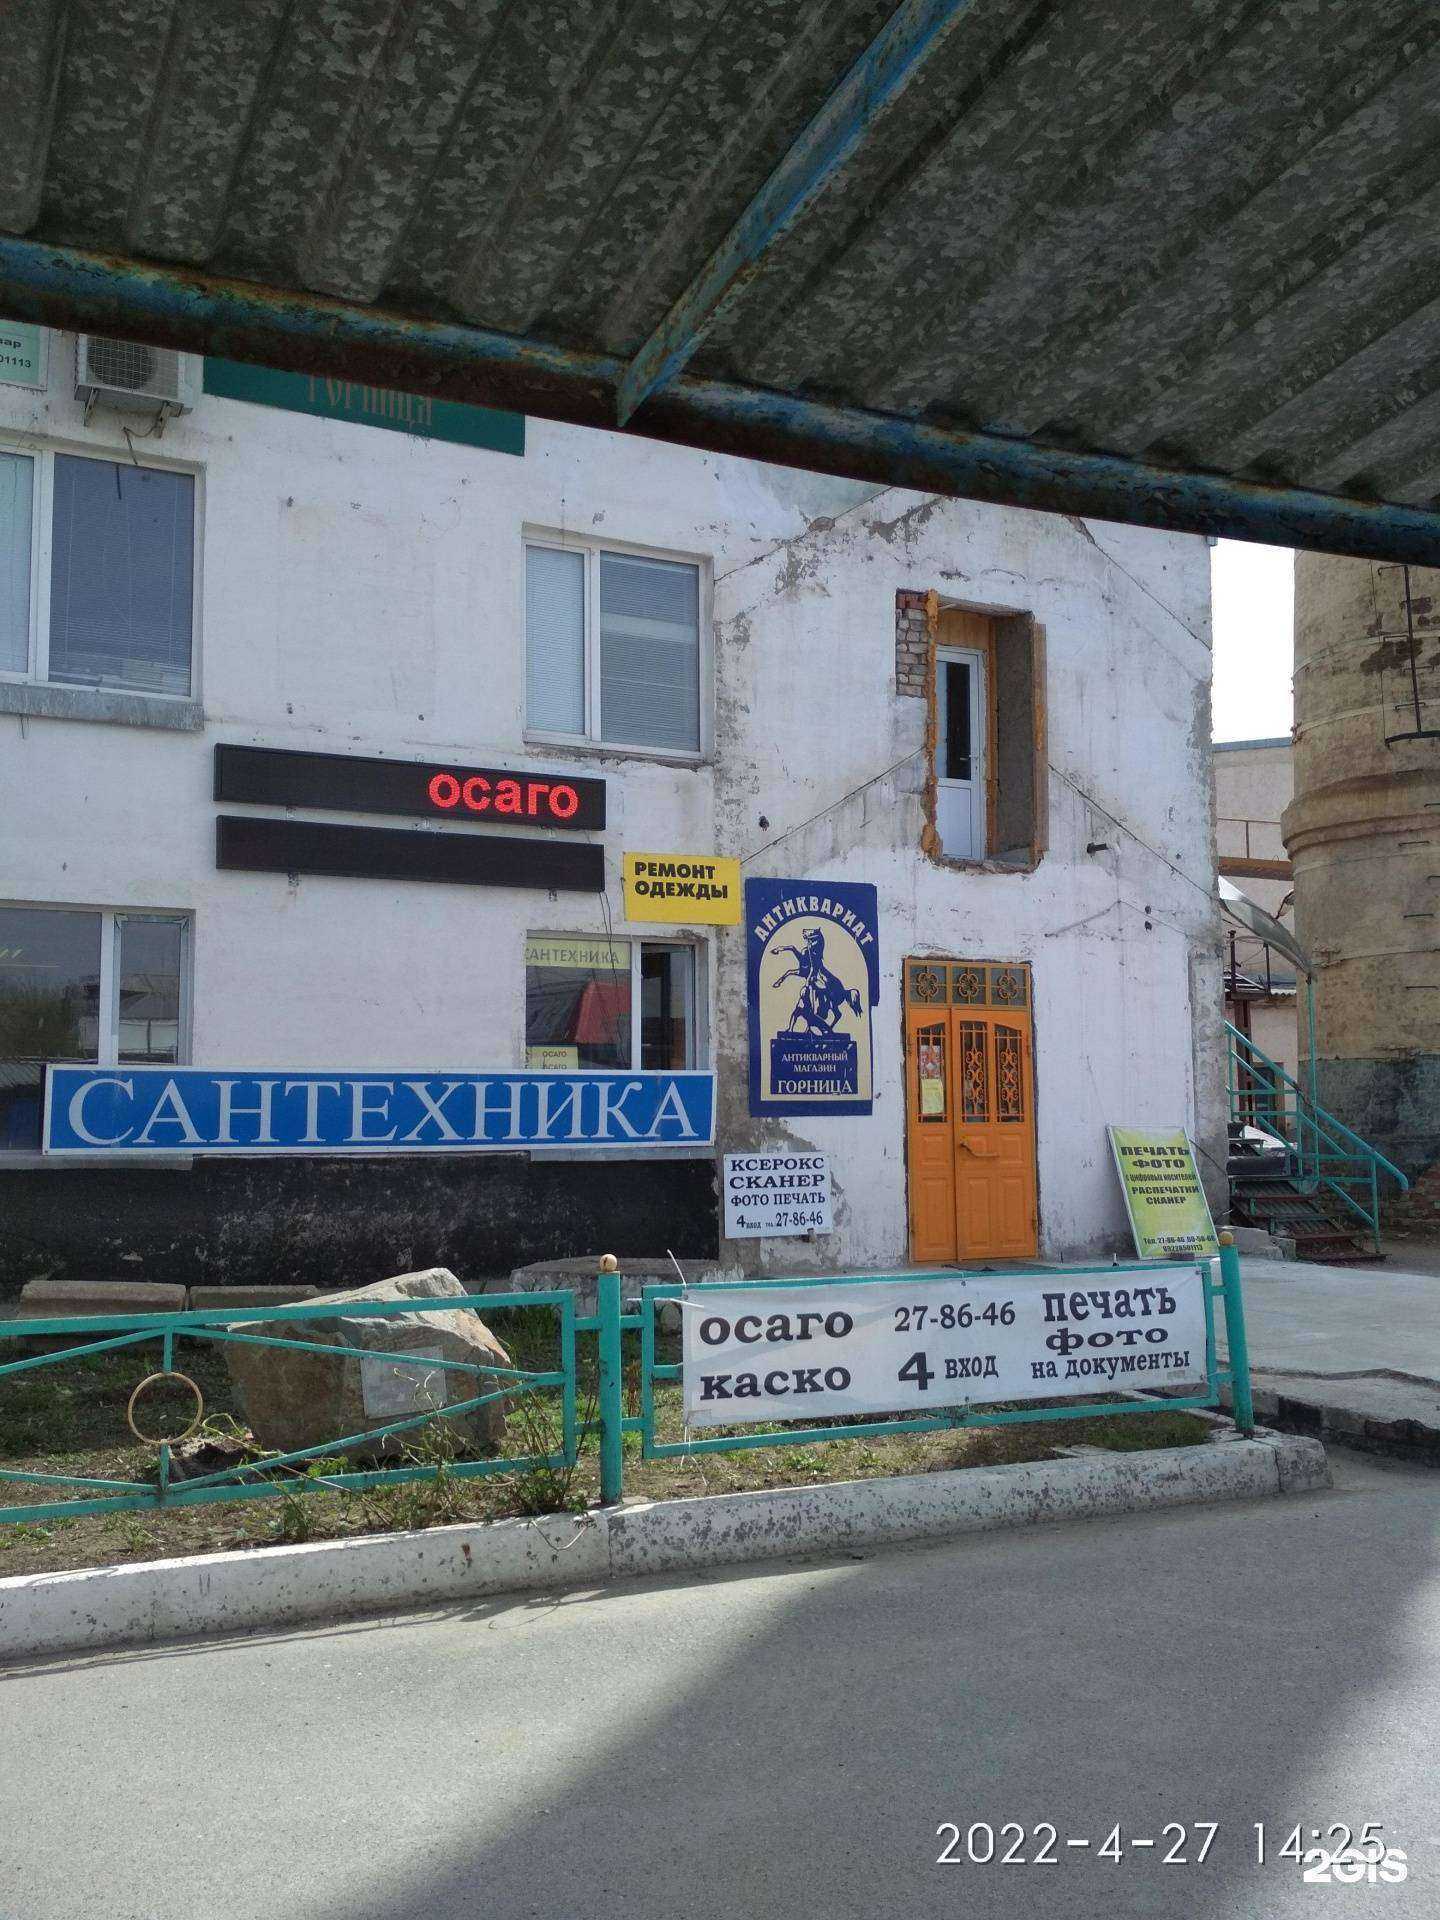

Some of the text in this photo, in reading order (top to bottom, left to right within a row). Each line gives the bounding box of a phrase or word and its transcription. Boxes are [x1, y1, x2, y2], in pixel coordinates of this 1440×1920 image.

[428, 774, 580, 821] осаго
[634, 861, 716, 880] РЕМОНТ
[634, 880, 728, 900] ОДЕЖДЫ
[754, 896, 874, 946] АНТИКВАРИАТ
[781, 1049, 848, 1062] АНТИКВАРНЫЙ
[793, 1063, 836, 1073] МАГАЗИН
[777, 1079, 853, 1095] ГОРНИЦА
[68, 1077, 699, 1146] САНТЕХНИКА
[1120, 1146, 1190, 1156] ПЕЧАТЬ
[731, 1158, 824, 1172] КСЕРОКС
[1132, 1159, 1186, 1169] ФОТО
[729, 1174, 825, 1189] СКАНЕР
[1131, 1185, 1201, 1195] РАСПЕЧАТКИ
[731, 1192, 826, 1207] ФОТО ПЕЧАТЬ
[1145, 1196, 1187, 1205] СКАНЕР
[775, 1211, 824, 1227] 27-86-46
[1042, 1287, 1177, 1322] печать
[894, 1301, 1016, 1333] 27-86-46
[699, 1311, 853, 1346] осаго
[1045, 1328, 1169, 1356] фото
[898, 1352, 999, 1391] 4 вход
[1030, 1350, 1190, 1380] на документы
[699, 1366, 851, 1400] каско
